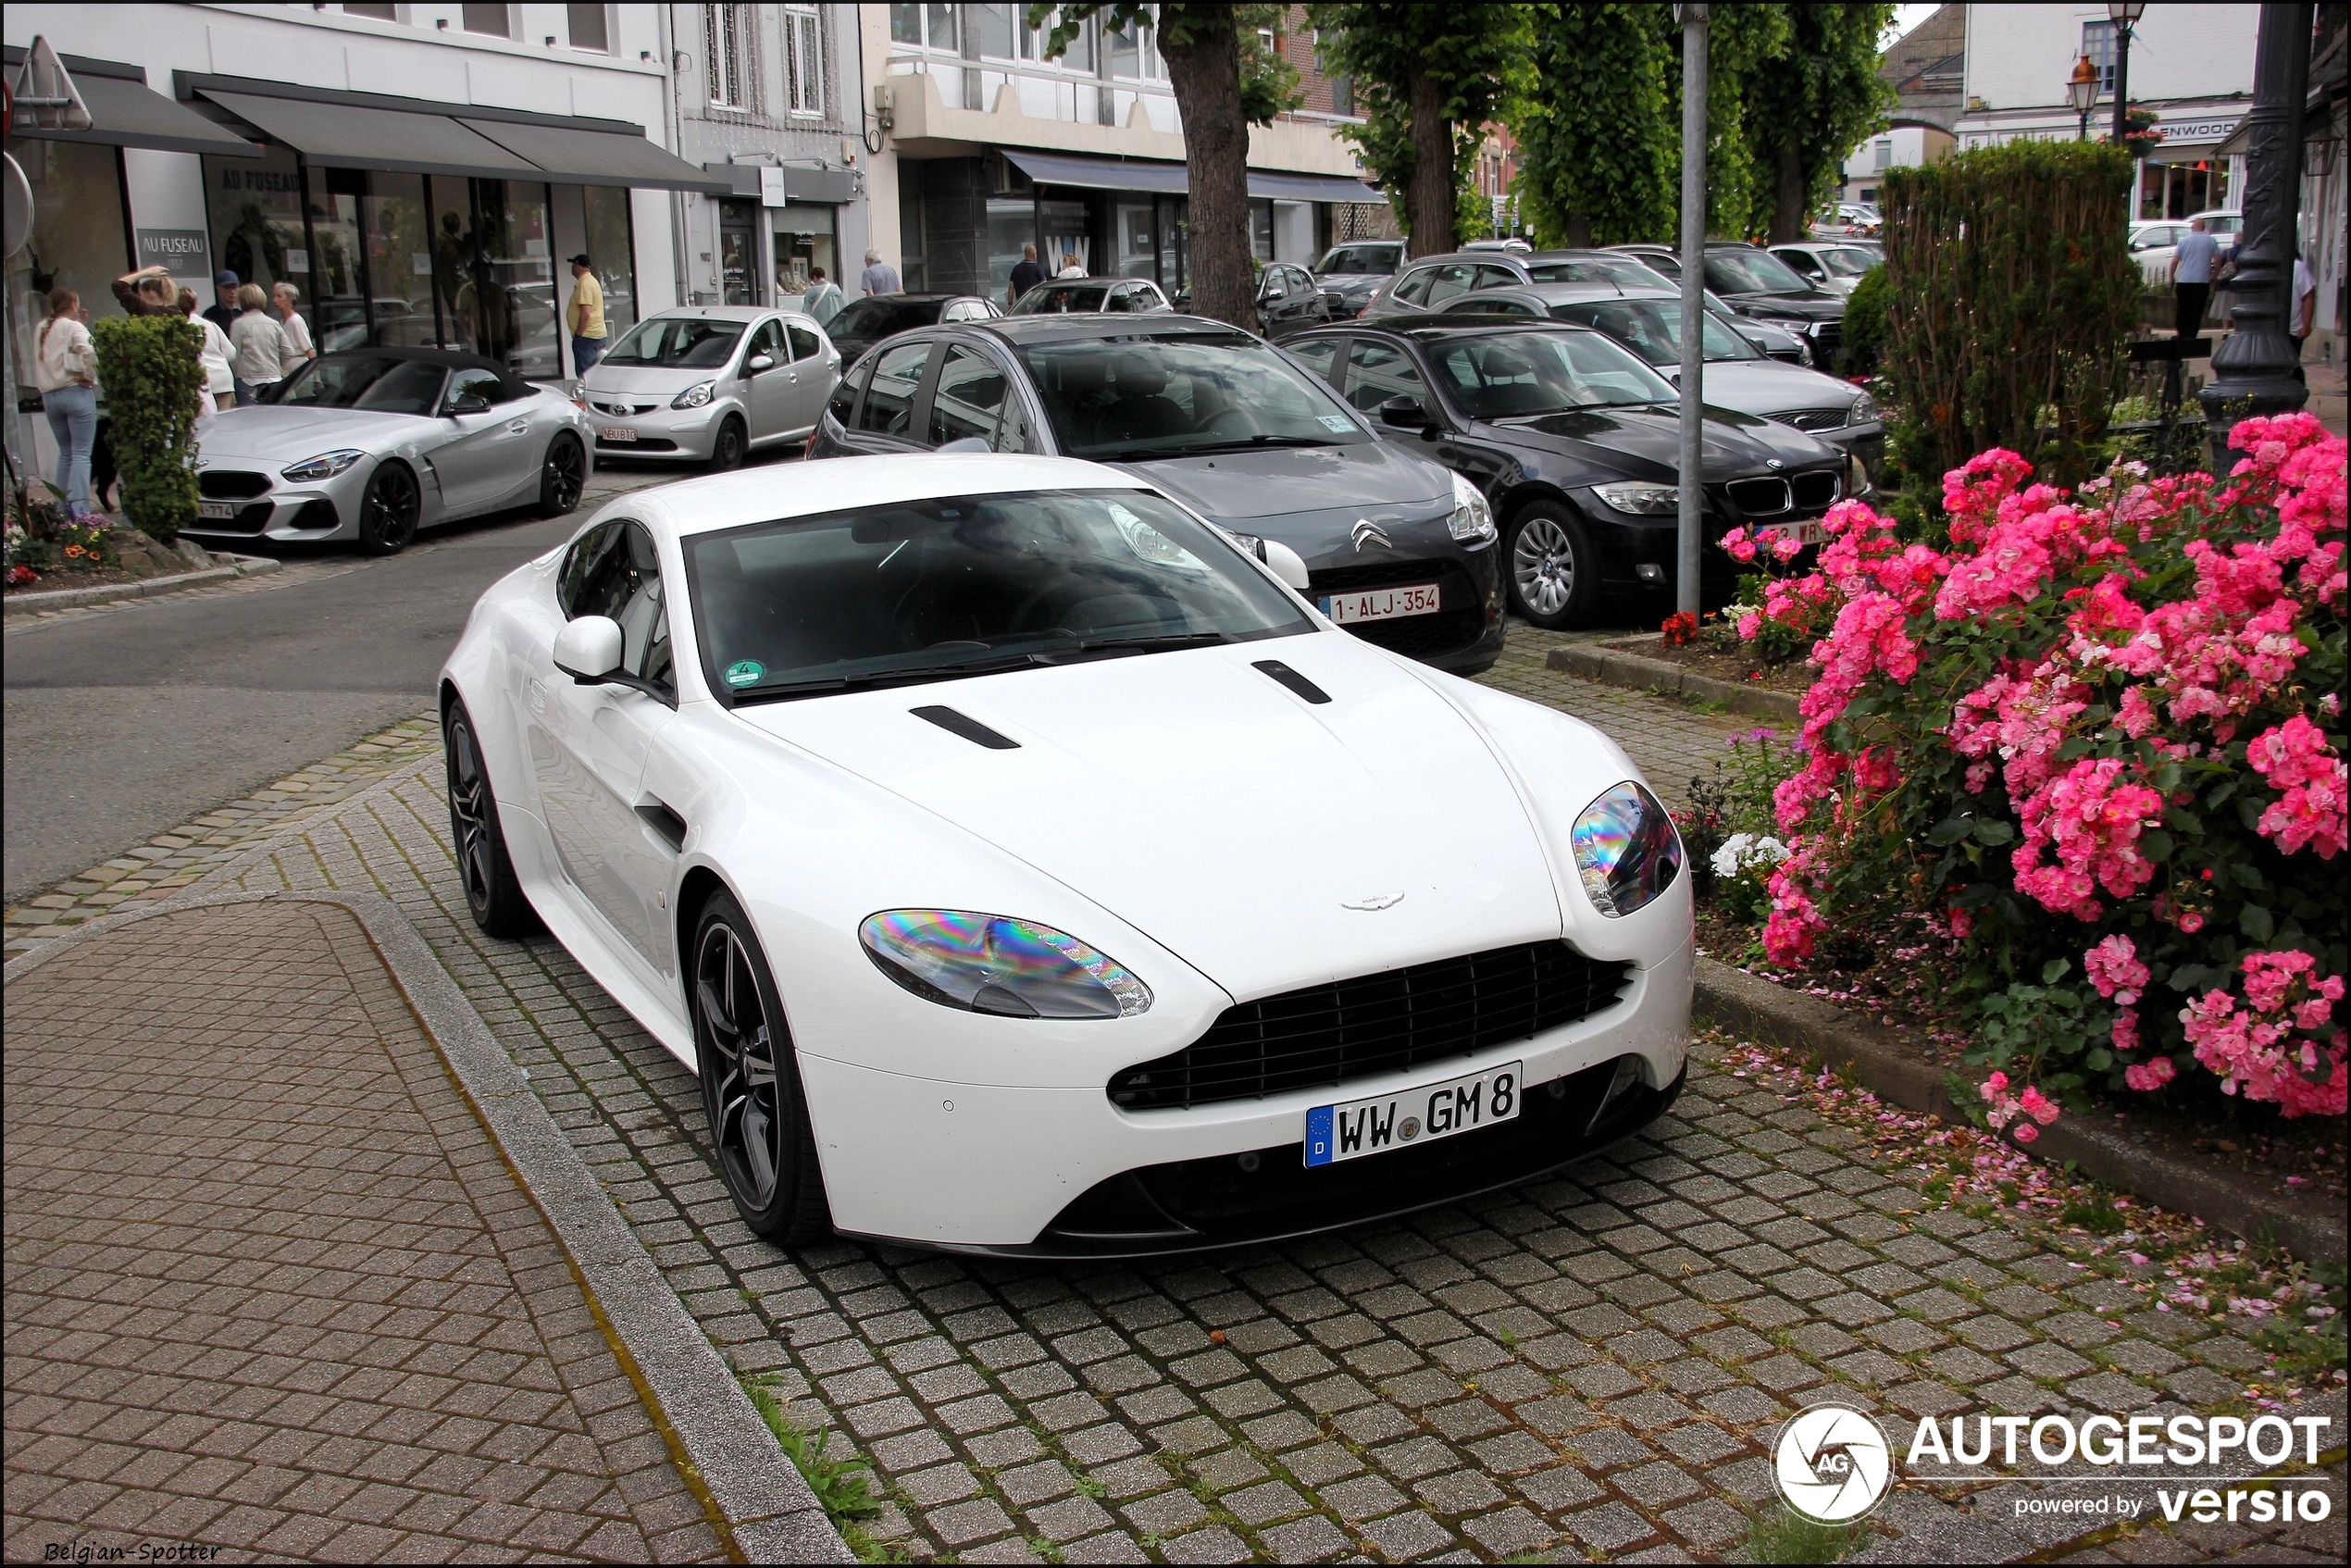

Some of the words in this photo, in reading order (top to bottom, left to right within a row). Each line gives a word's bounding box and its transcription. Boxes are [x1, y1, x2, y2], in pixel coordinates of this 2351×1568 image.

[223, 169, 241, 190] AU
[245, 170, 300, 193] FUSEAU
[143, 237, 159, 253] AU
[160, 237, 204, 254] FUSEAU
[1336, 589, 1436, 619] 1-ALJ-354
[739, 663, 750, 674] 4
[1338, 1101, 1397, 1153] WW
[1426, 1081, 1481, 1134] GM
[1490, 1073, 1514, 1117] 8
[1314, 1141, 1325, 1155] D
